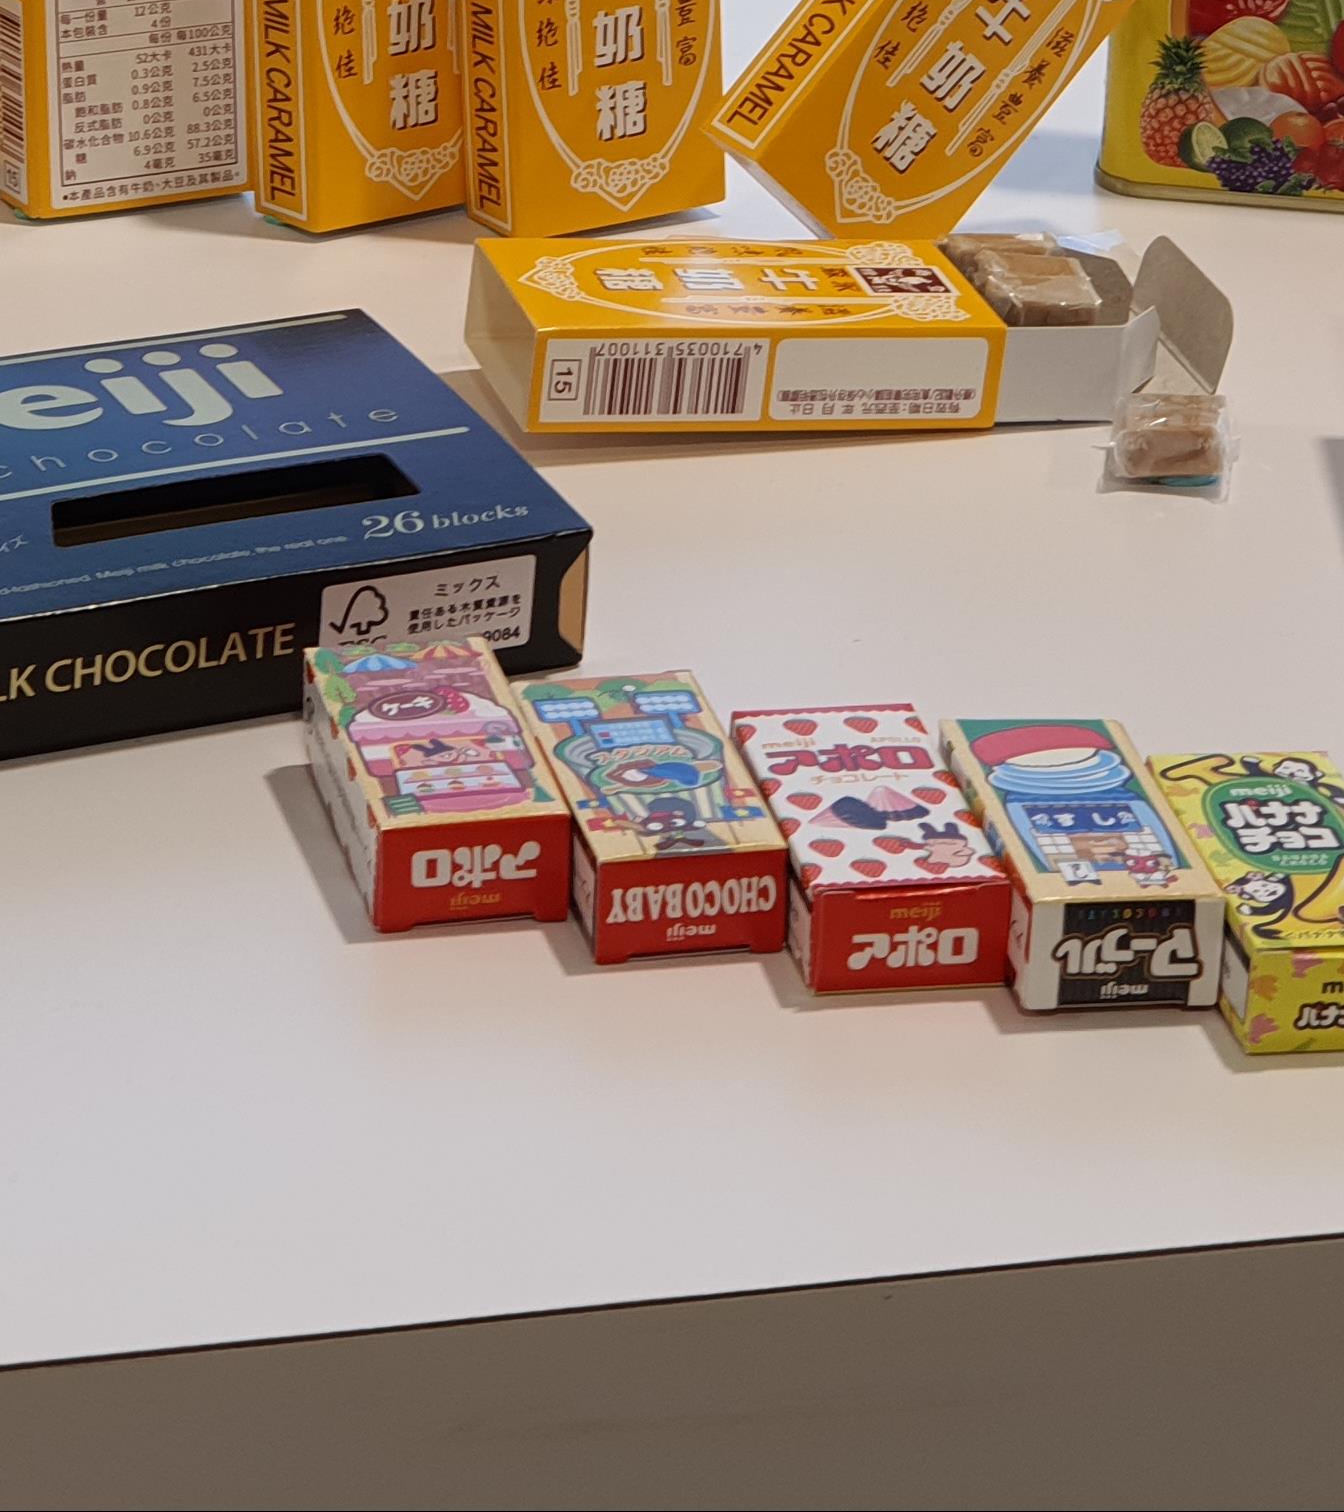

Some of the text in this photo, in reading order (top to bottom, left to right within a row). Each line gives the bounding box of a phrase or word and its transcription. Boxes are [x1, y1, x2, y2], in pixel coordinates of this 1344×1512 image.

[469, 1, 496, 70] MILK
[726, 11, 836, 125] CARAMEL
[265, 63, 296, 199] CARAMEL
[471, 74, 502, 209] CARAMEL
[595, 267, 821, 292] 牛奶糖
[555, 366, 573, 394] 15
[361, 499, 529, 541] 26 blocks
[434, 575, 501, 597] ミックス
[44, 622, 296, 694] CHOCOLATE
[380, 692, 437, 715] ケーキ
[766, 743, 935, 775] アポロ
[1229, 785, 1294, 797] meiji
[1223, 799, 1323, 827] バナナ
[1236, 826, 1341, 853] チョコ
[410, 840, 542, 889] アポロ
[450, 891, 502, 912] meiji
[606, 875, 777, 925] CHOCOBABY
[889, 901, 943, 922] meiji
[665, 923, 716, 942] meiji
[846, 925, 979, 971] アポロ
[1055, 928, 1198, 976] マーブル
[1099, 981, 1149, 999] meiji
